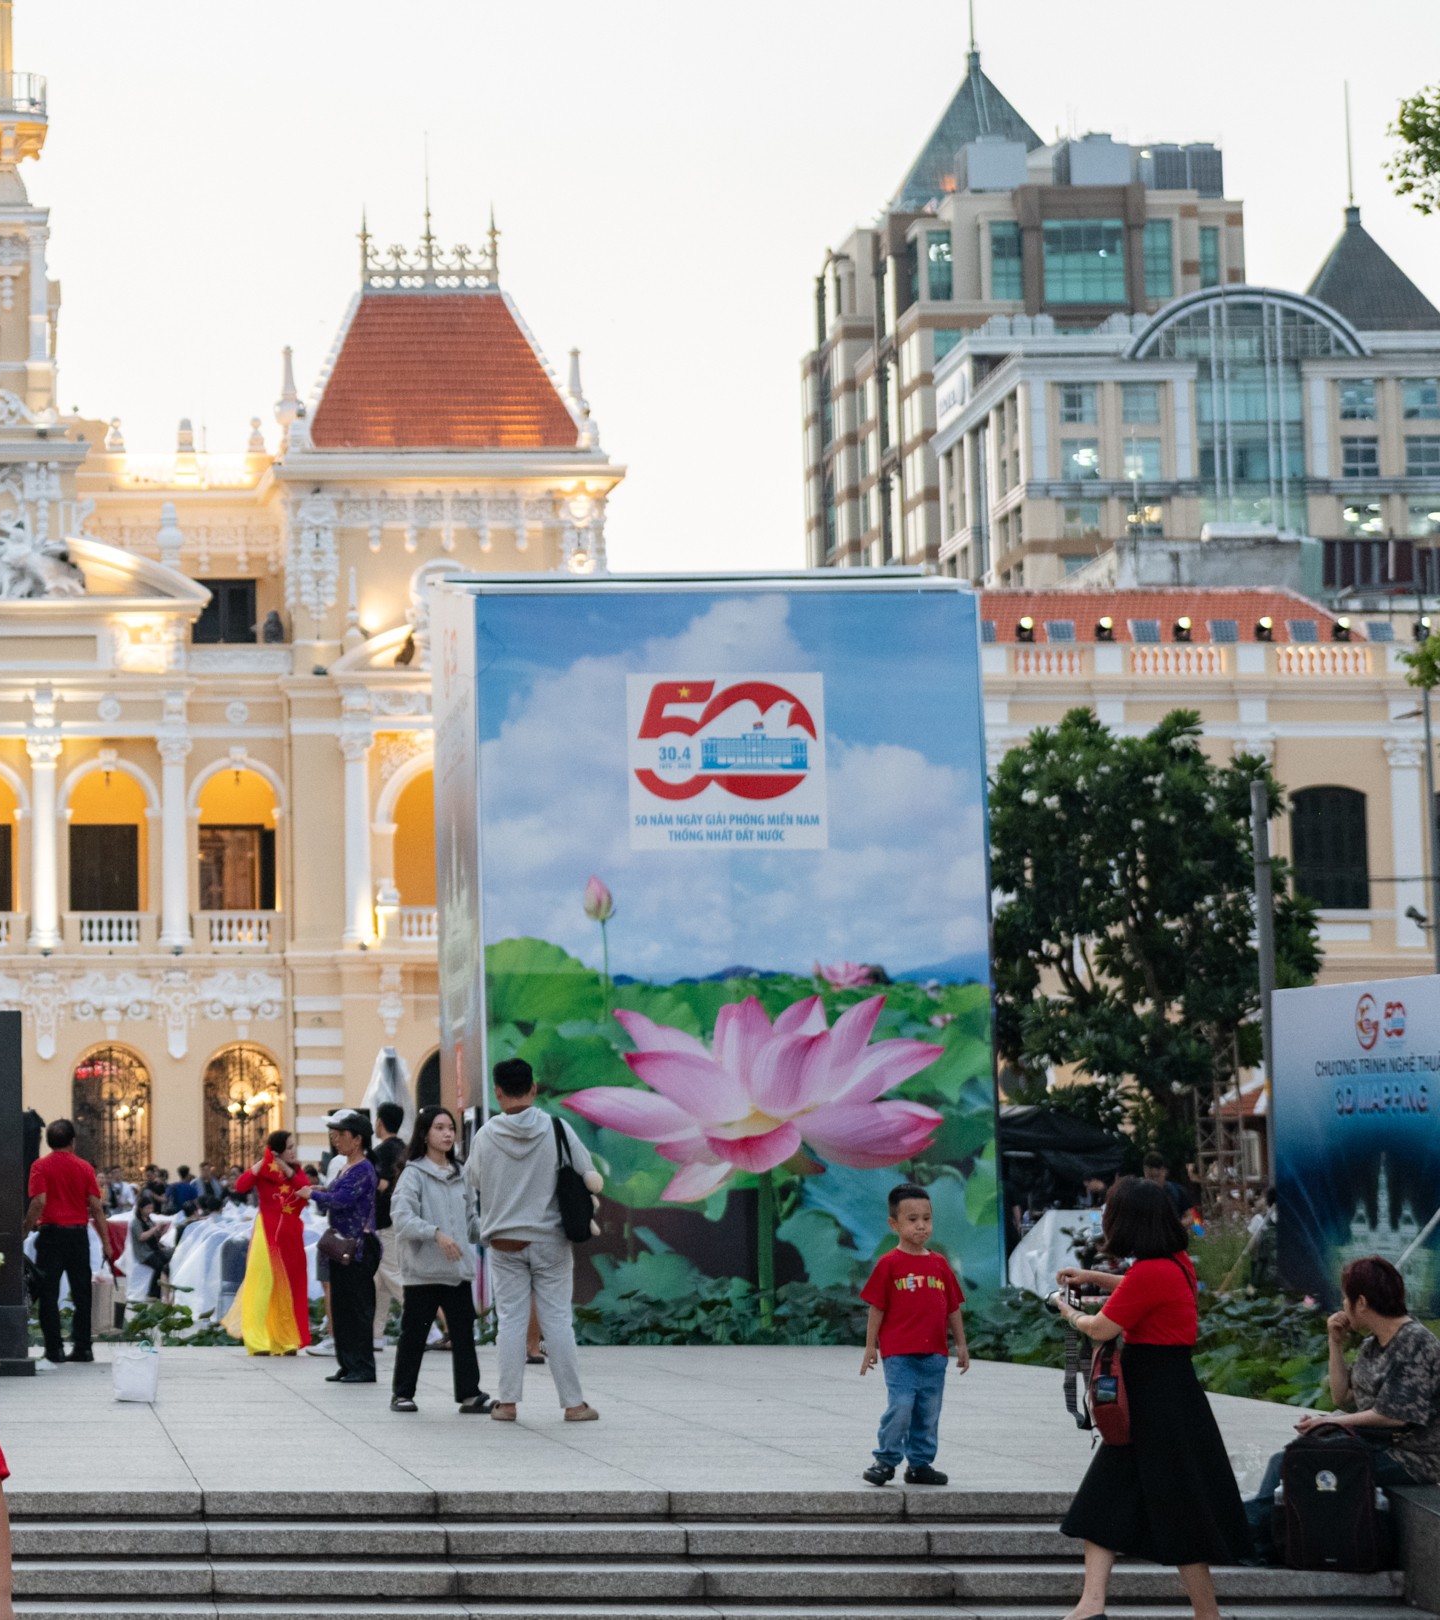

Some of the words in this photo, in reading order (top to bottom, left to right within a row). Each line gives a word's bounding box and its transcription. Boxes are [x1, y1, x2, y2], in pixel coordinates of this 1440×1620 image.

[659, 746, 691, 761] 30.4
[635, 814, 647, 826] 50
[650, 812, 673, 826] NĂM
[676, 811, 702, 825] NGÀY
[729, 811, 765, 825] PHÓNG
[796, 814, 820, 825] NAM
[894, 1272, 925, 1292] VIỆT
